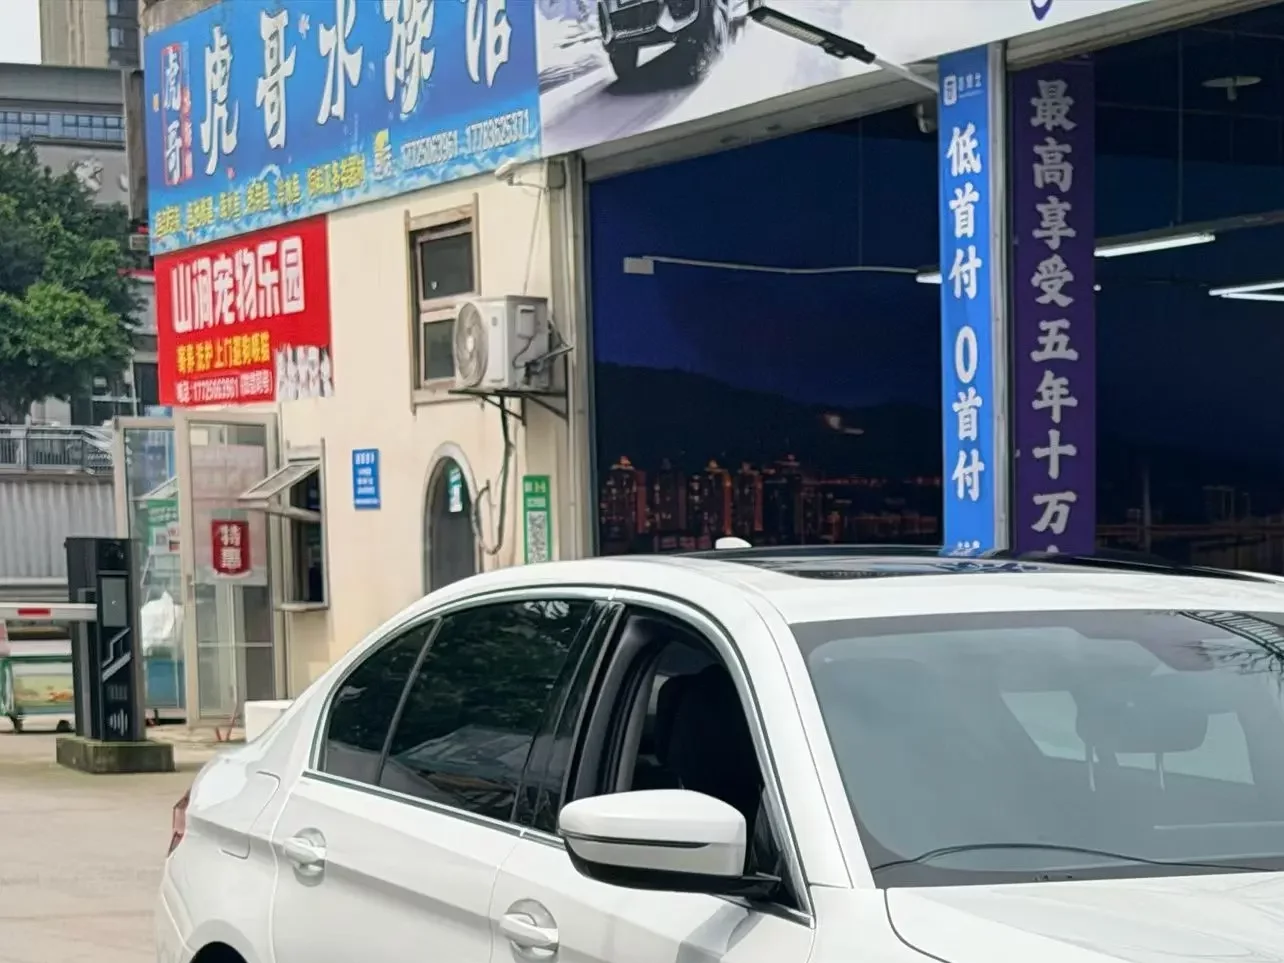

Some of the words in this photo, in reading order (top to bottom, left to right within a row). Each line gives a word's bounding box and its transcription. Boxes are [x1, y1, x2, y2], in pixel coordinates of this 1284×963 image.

[946, 122, 982, 299] 低首付
[1030, 79, 1079, 552] 最高享受五年十万
[951, 325, 985, 502] 0首付
